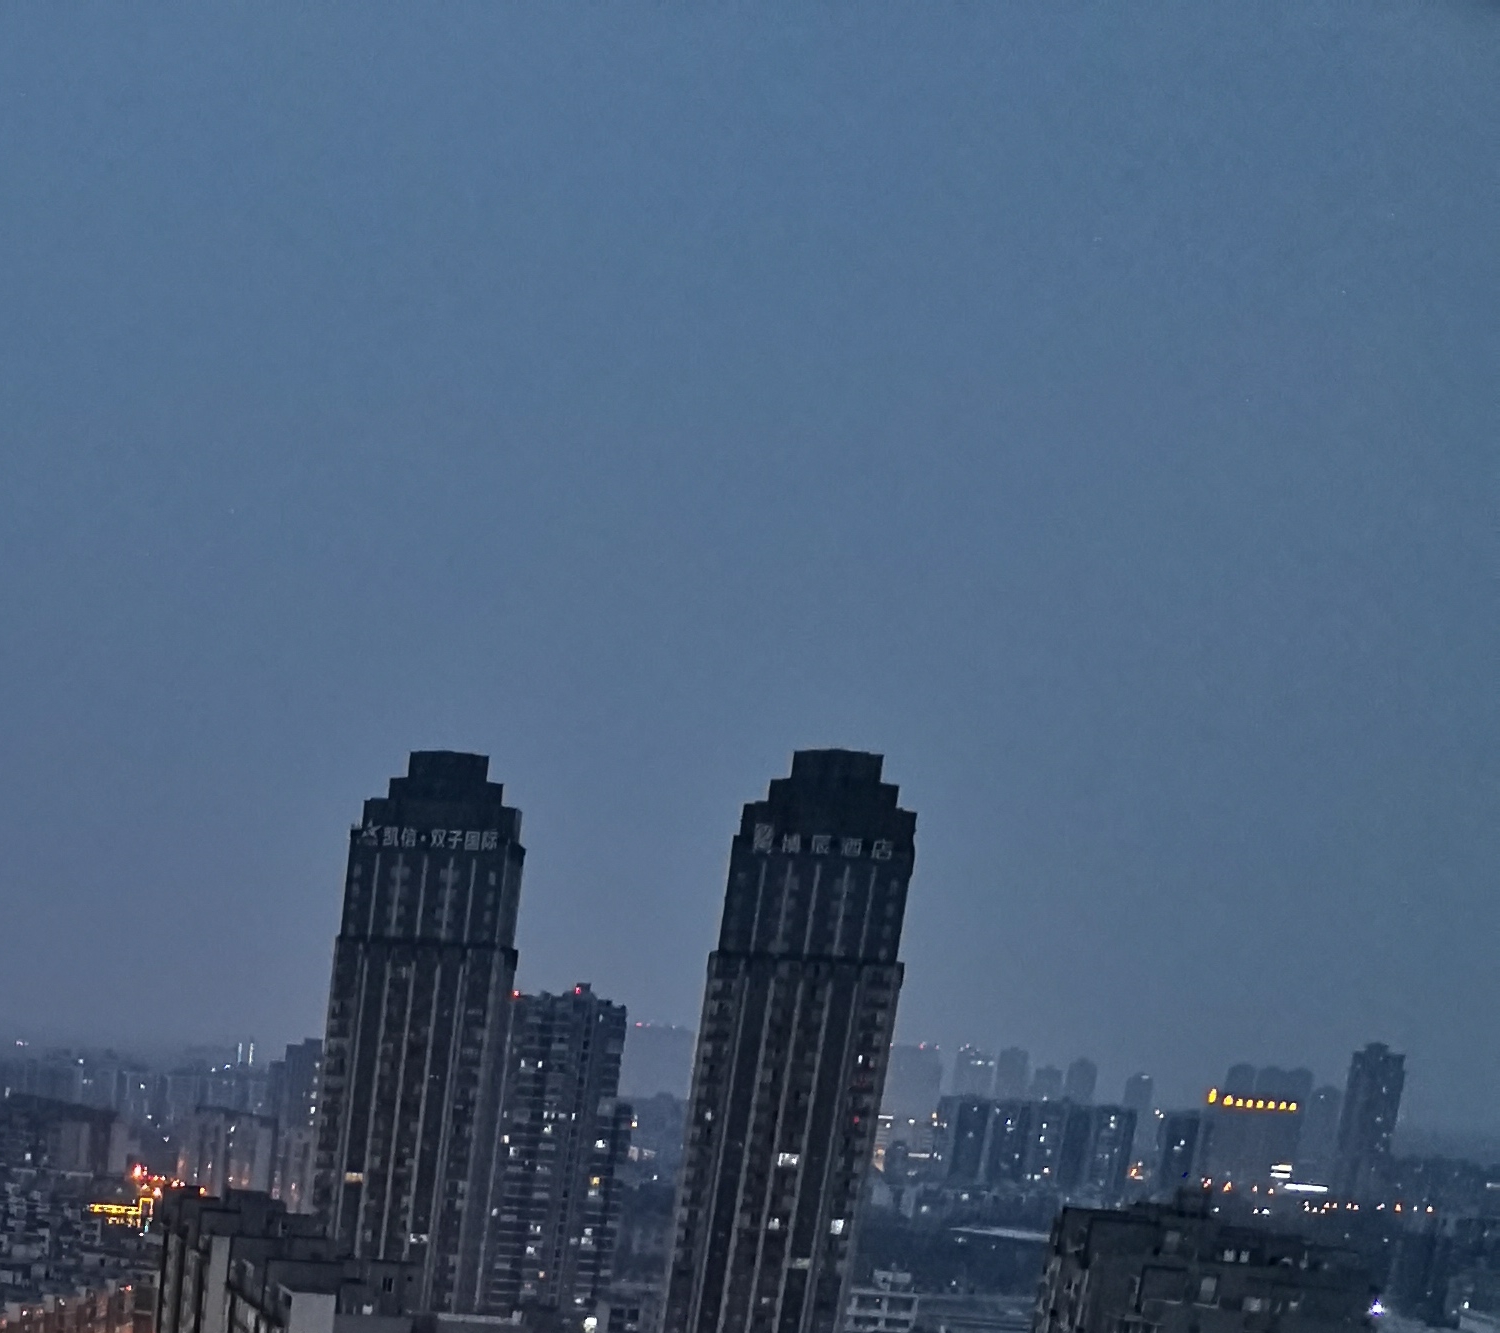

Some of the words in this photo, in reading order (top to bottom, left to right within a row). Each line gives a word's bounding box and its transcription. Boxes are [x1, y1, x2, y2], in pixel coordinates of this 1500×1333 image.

[382, 826, 499, 851] 凯信·双子国际
